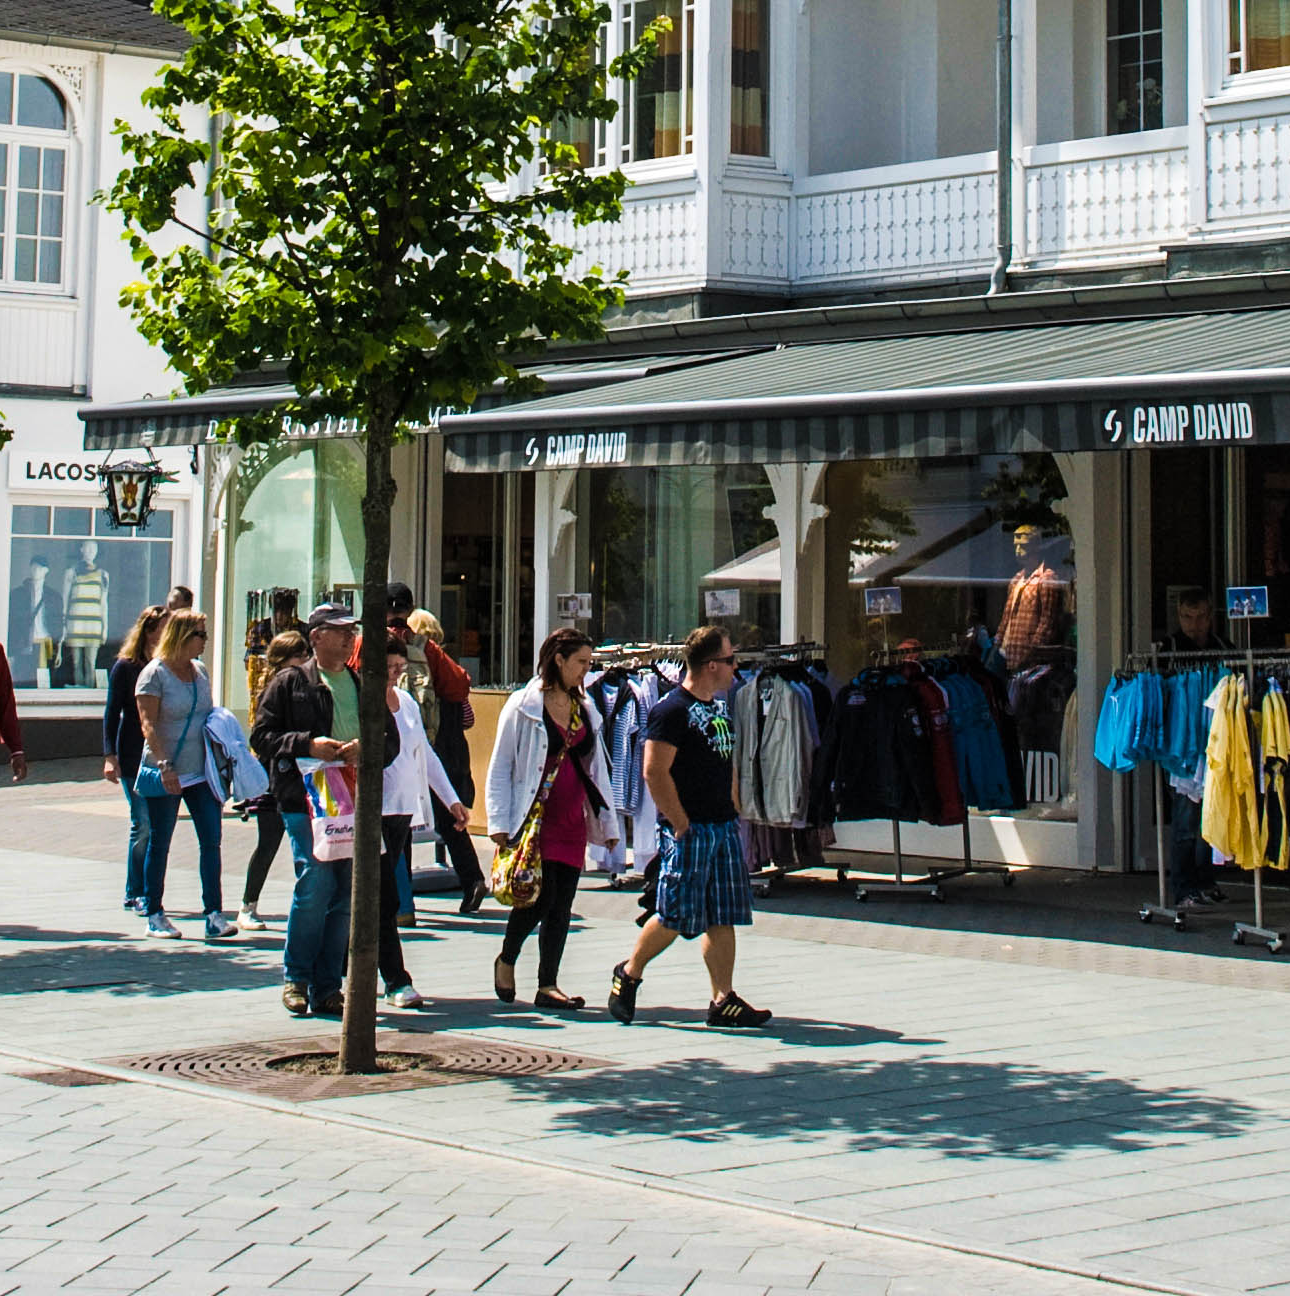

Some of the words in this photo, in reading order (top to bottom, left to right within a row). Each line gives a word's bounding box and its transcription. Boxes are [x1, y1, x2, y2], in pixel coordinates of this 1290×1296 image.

[1133, 405, 1189, 443] CAMP
[1193, 403, 1253, 441] DAVID
[546, 434, 585, 466] CAMP
[585, 432, 627, 464] DAVID
[26, 461, 98, 481] LACOS
[1020, 750, 1059, 802] VID
